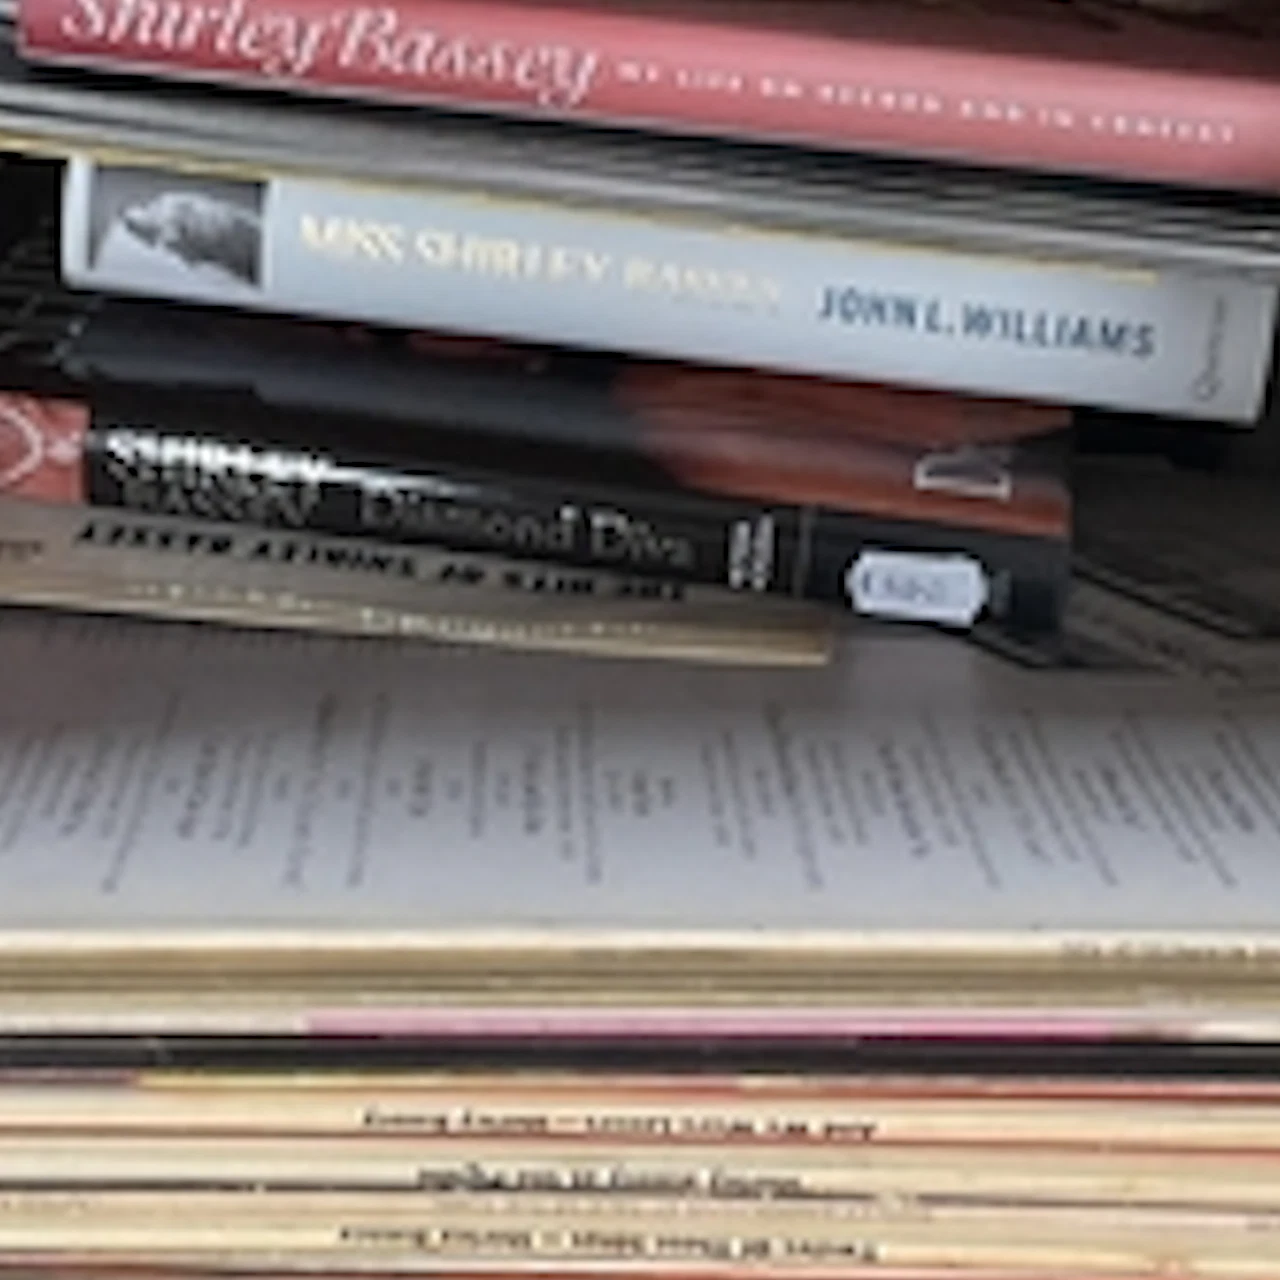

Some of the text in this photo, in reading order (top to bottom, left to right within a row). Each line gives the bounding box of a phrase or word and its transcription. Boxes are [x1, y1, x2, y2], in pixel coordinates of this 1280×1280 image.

[326, 6, 597, 109] Bassey
[298, 213, 399, 261] MISS
[412, 226, 611, 286] SHIRLEY
[817, 283, 919, 328] JOHN
[960, 300, 1157, 360] WILLIAMS
[361, 484, 575, 554] Diamond
[591, 510, 697, 570] Diva
